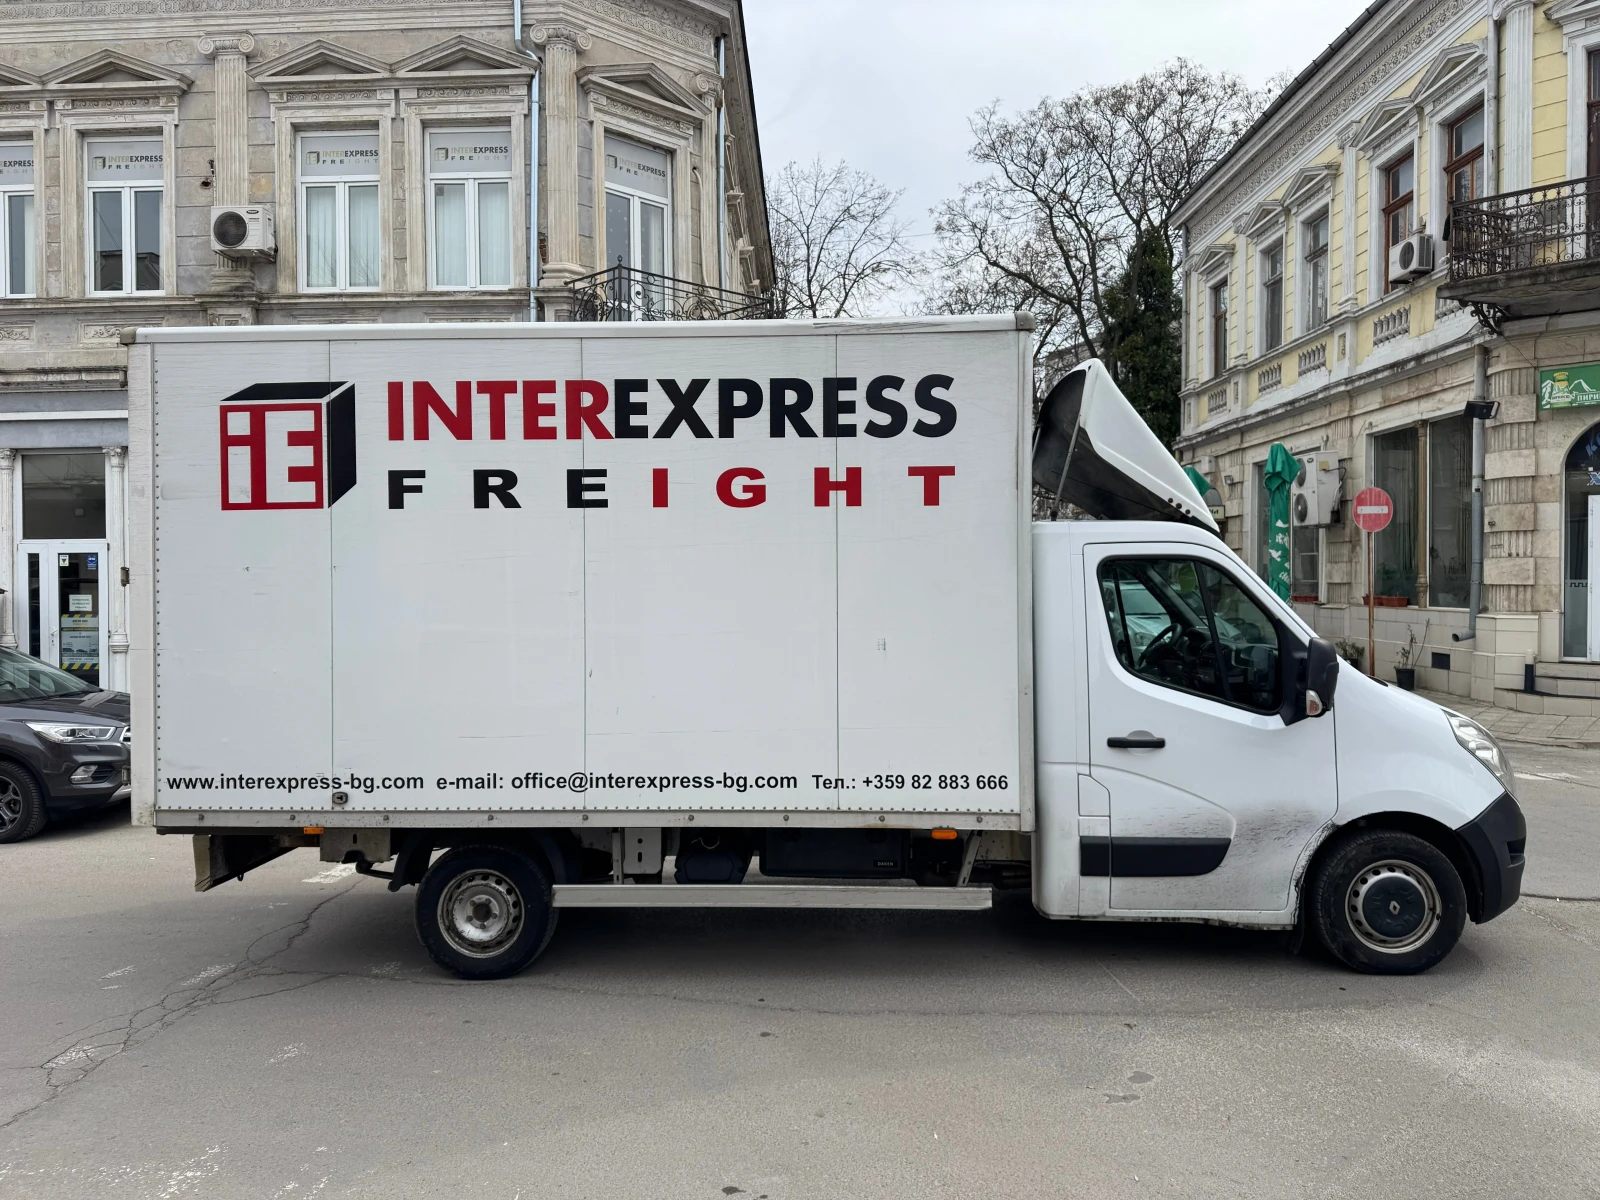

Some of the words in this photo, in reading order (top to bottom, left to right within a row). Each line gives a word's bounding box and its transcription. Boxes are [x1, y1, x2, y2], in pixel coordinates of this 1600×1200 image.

[322, 150, 379, 158] INTEREXPRESS
[451, 146, 509, 154] INTEREXPRESS
[108, 155, 163, 163] INTEREXPRESS
[1577, 393, 1600, 401] ПИРИ
[387, 374, 957, 440] INTEREXPRESS
[388, 466, 956, 509] FREIGHT
[167, 773, 424, 793] www.interexpress-bg.com
[436, 773, 504, 790] e-mail:
[511, 773, 798, 793] office@interexpress-bg.com
[812, 774, 856, 790] Тел.:
[862, 774, 905, 789] +359
[911, 774, 932, 789] 82
[938, 774, 970, 789] 883
[976, 774, 1009, 789] 666
